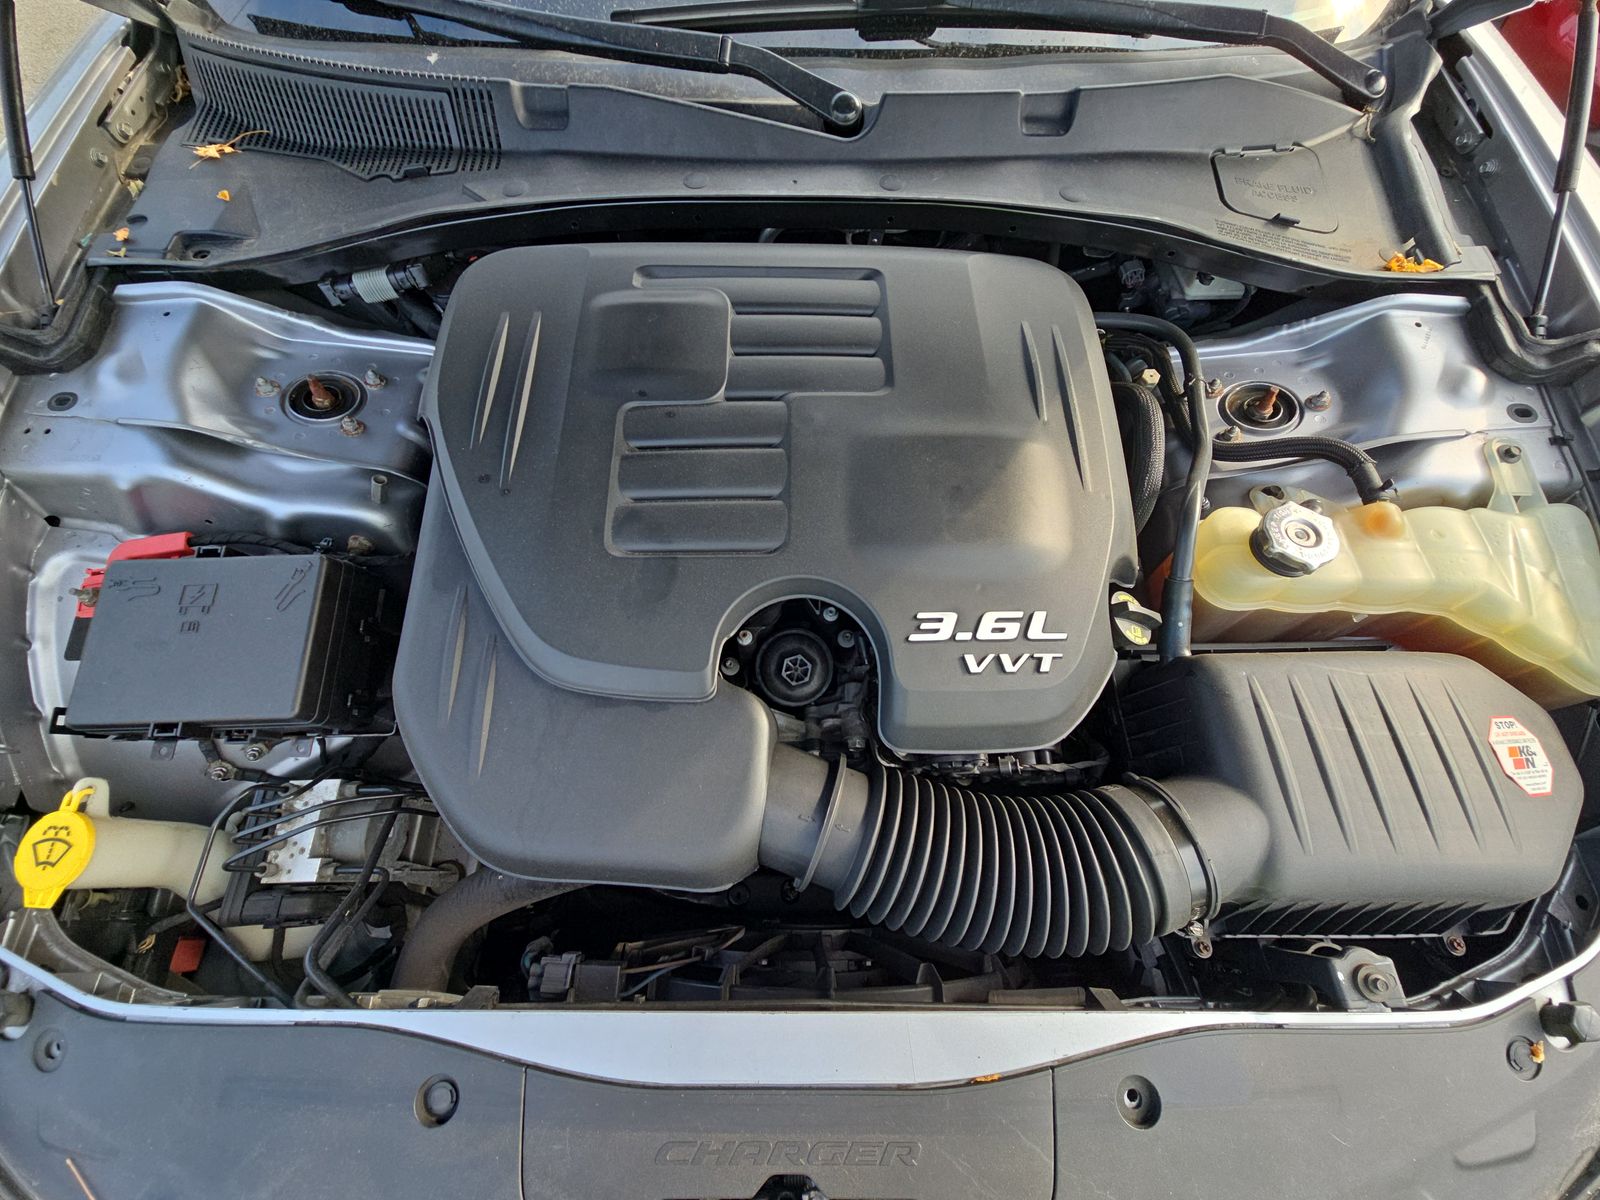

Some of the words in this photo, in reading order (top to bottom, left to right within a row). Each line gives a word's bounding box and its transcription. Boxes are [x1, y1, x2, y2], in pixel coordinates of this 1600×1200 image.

[1276, 184, 1313, 195] FLUID
[906, 610, 1068, 642] 3.6L
[962, 653, 1064, 673] VVT
[654, 1140, 922, 1166] CHARGER
